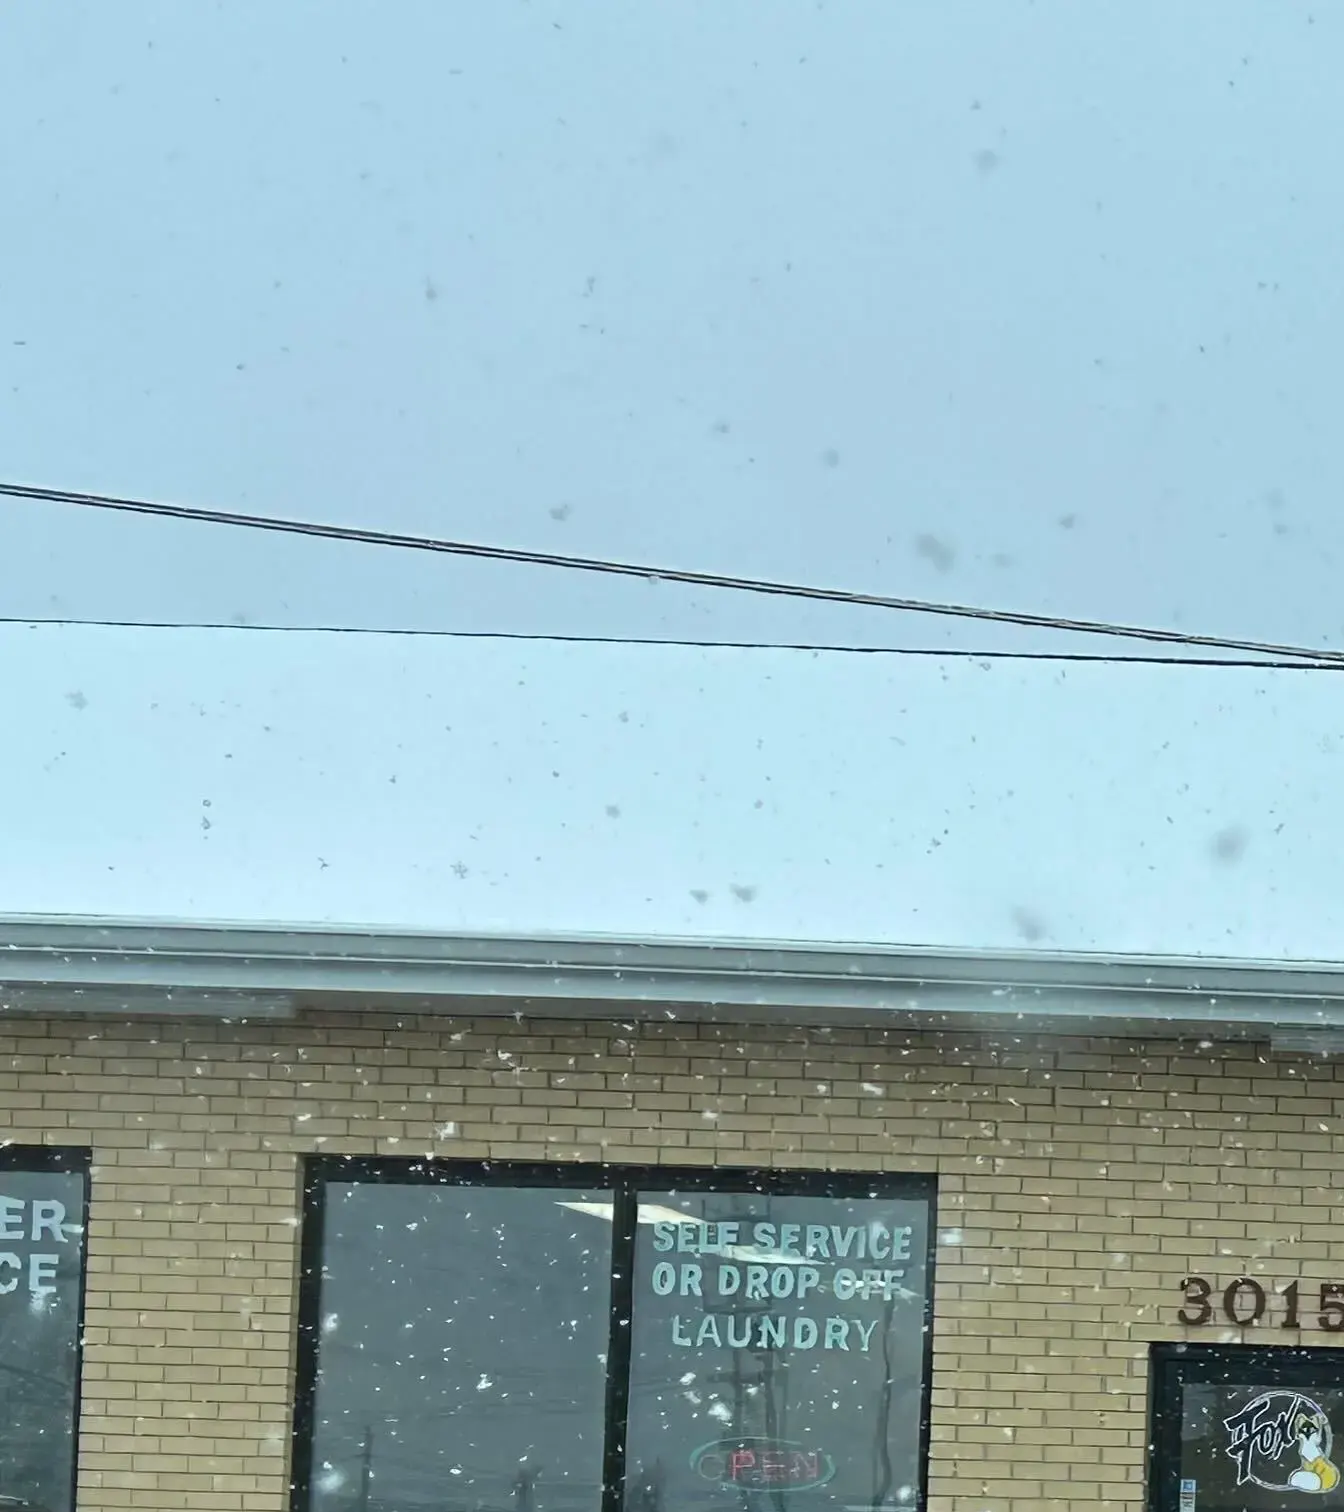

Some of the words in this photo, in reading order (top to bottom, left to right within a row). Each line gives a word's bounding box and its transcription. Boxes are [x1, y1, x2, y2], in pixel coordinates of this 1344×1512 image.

[653, 1221, 741, 1253] SELF
[753, 1222, 913, 1260] SERVICE
[652, 1261, 703, 1297] OR
[718, 1264, 820, 1300] DROP
[833, 1268, 905, 1301] OFF
[671, 1314, 879, 1352] LAUNDRY
[1223, 1394, 1302, 1485] Fox
